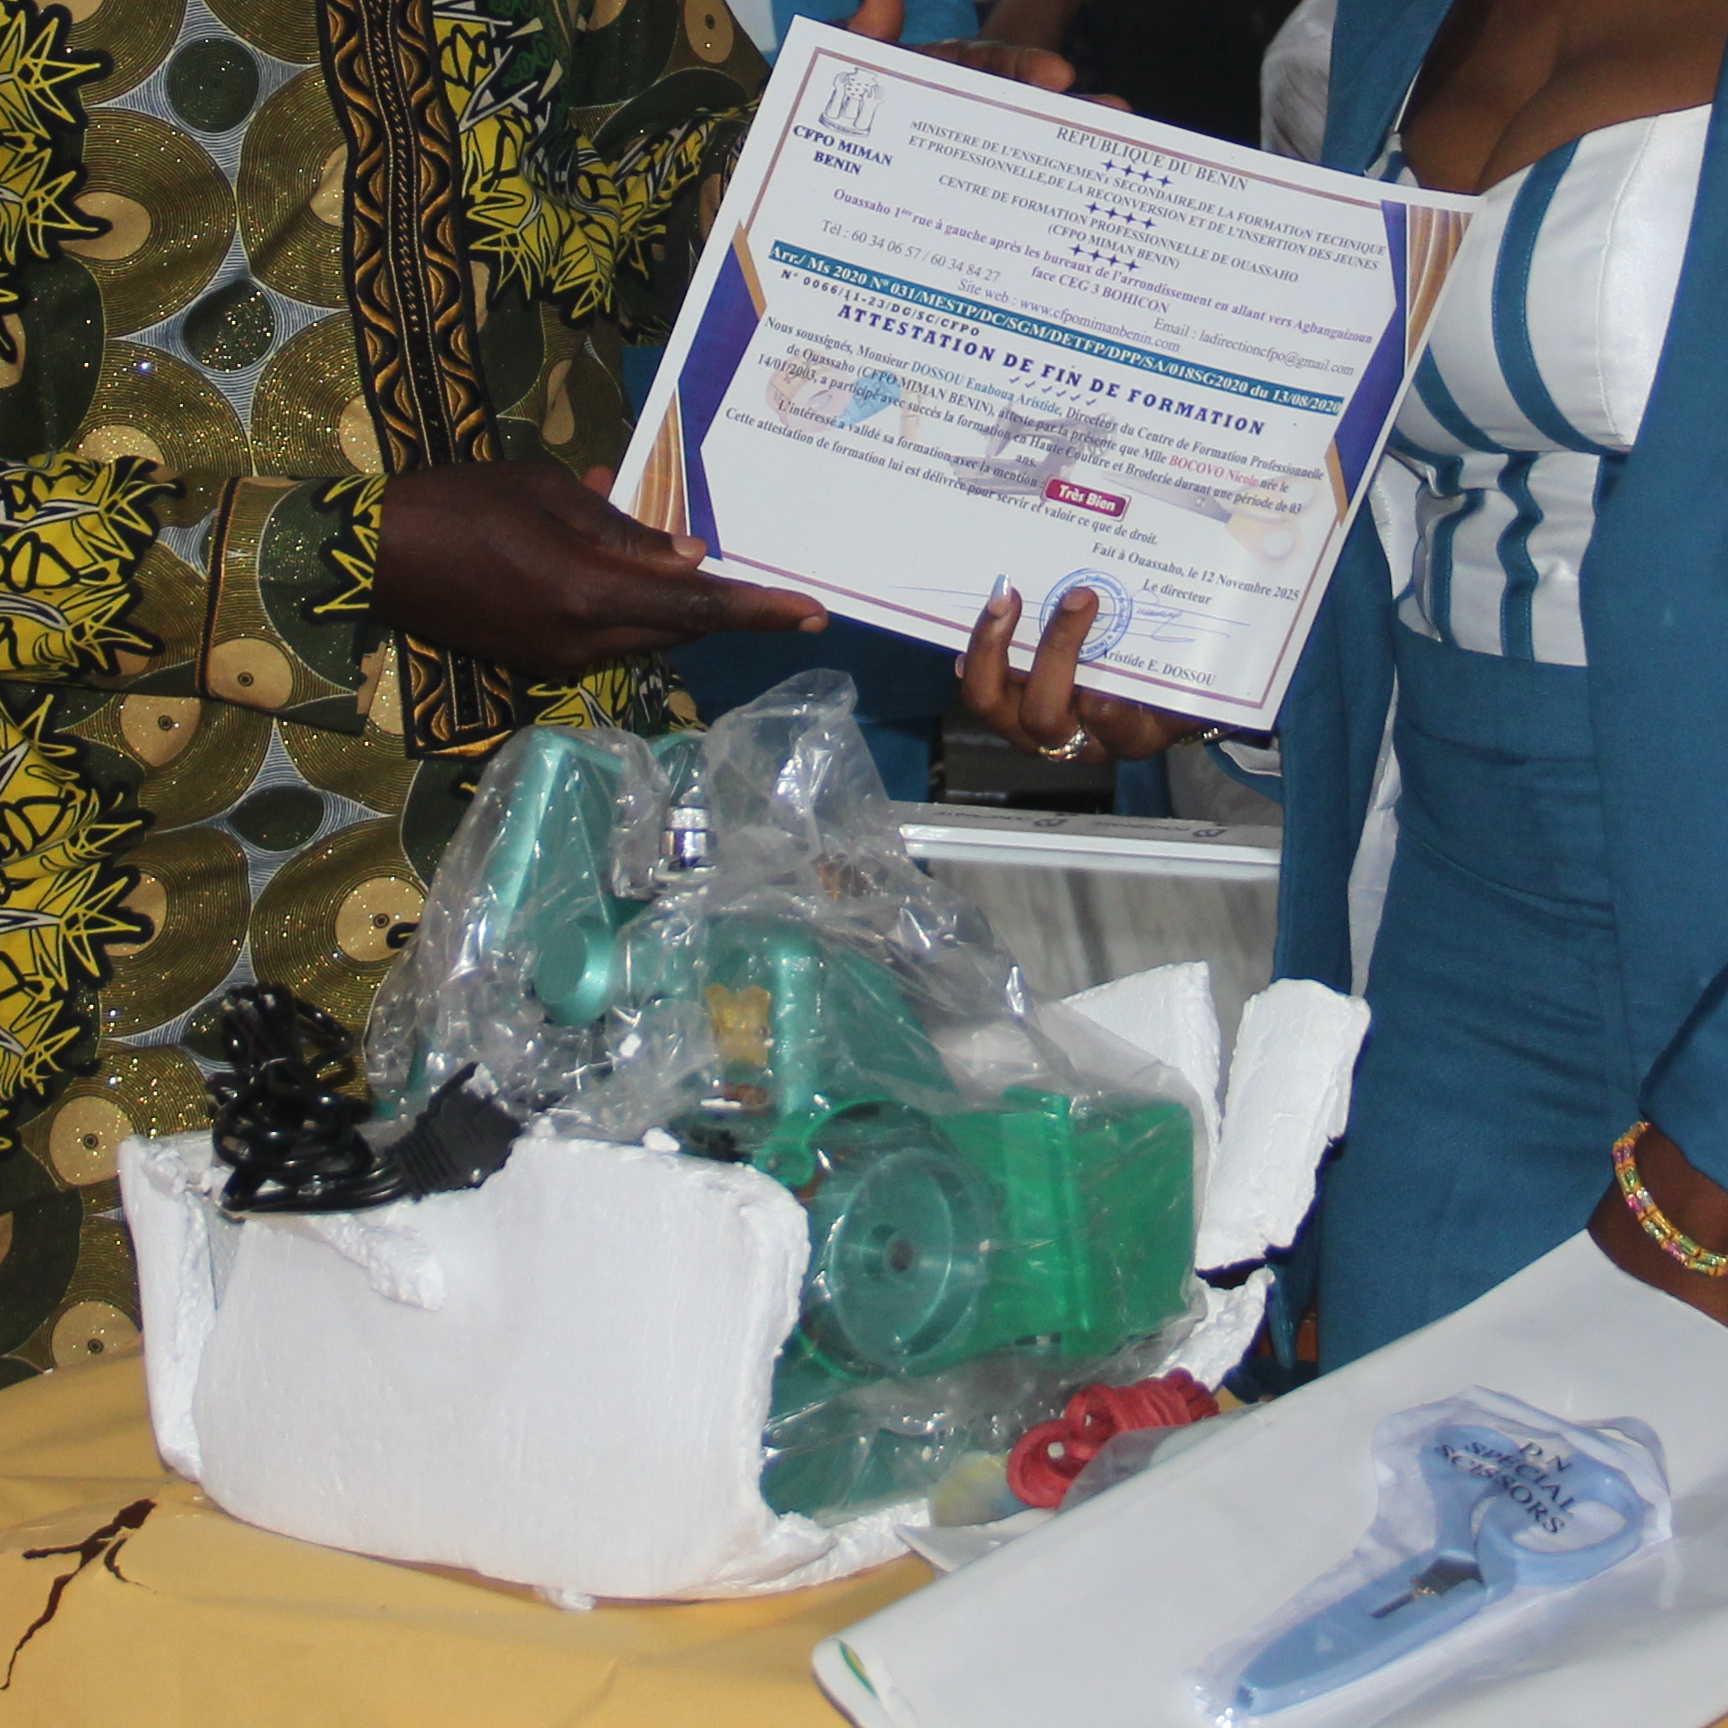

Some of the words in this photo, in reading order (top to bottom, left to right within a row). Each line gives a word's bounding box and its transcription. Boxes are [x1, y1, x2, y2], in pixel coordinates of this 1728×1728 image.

[791, 123, 836, 147] CFPO
[836, 138, 892, 166] MIMAN
[812, 150, 862, 175] BENIN
[1055, 126, 1165, 169] REPUBLIQUE
[1166, 158, 1188, 175] DU
[1194, 166, 1248, 191] BENIN
[907, 134, 927, 149] ET
[1066, 180, 1084, 194] LA
[1085, 185, 1186, 222] RECONVERSION
[1187, 214, 1206, 228] ET
[1206, 219, 1226, 233] DE
[1226, 224, 1307, 254] L'INSERTION
[1307, 245, 1333, 261] DES
[1332, 251, 1378, 270] JEUNES
[937, 173, 990, 197] CENTRE
[990, 188, 1010, 203] DE
[1010, 194, 1088, 225] FORMATION
[1088, 217, 1209, 259] PROFESSIONNELLE
[1210, 250, 1230, 265] DE
[1229, 256, 1299, 283] OUASSAHO
[980, 138, 1000, 153] DE
[1216, 205, 1235, 220] LA
[1236, 210, 1312, 239] FORMATION
[1314, 230, 1387, 256] TECHNIQUE
[820, 219, 842, 237] Tél
[849, 229, 868, 244] 60
[868, 234, 886, 249] 34
[885, 239, 903, 255] 06
[903, 244, 922, 260] 57
[929, 252, 947, 268] 60
[947, 256, 965, 273] 34
[965, 262, 983, 278] 84
[982, 267, 1001, 283] 27
[832, 187, 891, 215] Ouassaho
[911, 212, 934, 228] rue
[943, 222, 988, 245] gauche
[987, 235, 1022, 255] après
[1022, 244, 1041, 259] les
[1042, 250, 1093, 274] bureaux
[1094, 265, 1111, 279] de
[1110, 269, 1212, 307] l'arrondissement
[1230, 303, 1266, 321] allant
[1267, 313, 1293, 327] vers
[1046, 223, 1087, 242] (CFPO
[1087, 233, 1134, 256] MIMAN
[1135, 247, 1180, 269] BENIN)
[956, 278, 982, 296] Site
[983, 287, 1010, 304] web
[1018, 298, 1180, 353] www.cfpomimanbenin.com
[1029, 265, 1057, 283] face
[1057, 273, 1090, 292] CEG
[1100, 285, 1168, 314] BOHICON
[806, 256, 831, 274] Ms
[831, 264, 868, 285] 2020
[1248, 383, 1270, 398] du
[1271, 388, 1341, 416] 13/08/2020
[837, 303, 995, 361] ATTESTATION
[1002, 352, 1034, 373] DE
[1040, 363, 1082, 386] FIN
[1088, 376, 1121, 397] DE
[1126, 388, 1264, 435] FORMATION
[1152, 316, 1191, 337] Email
[1198, 329, 1354, 377] ladirectioncfpo@gmail.com
[763, 315, 794, 335] Nous
[794, 326, 854, 355] soussignés,
[855, 344, 910, 370] Monsieur
[910, 360, 962, 386] DOSSOU
[964, 376, 1015, 402] Enaboua
[1017, 392, 1064, 416] Aristide,
[1065, 406, 1119, 431] Directeur
[1119, 421, 1136, 436] du
[1136, 426, 1175, 446] Centre
[1175, 436, 1191, 450] de
[1191, 440, 1248, 464] Formation
[1249, 455, 1324, 480] Professionnelle
[785, 342, 801, 357] de
[801, 347, 856, 373] Ouassaho
[856, 365, 898, 386] (CFPO
[898, 376, 946, 400] MIMAN
[947, 391, 996, 416] BENIN),
[997, 407, 1034, 427] atteste
[1034, 419, 1058, 434] par
[1069, 429, 1118, 451] présente
[1117, 443, 1141, 457] que
[1140, 447, 1168, 464] Mlle
[1167, 454, 1225, 478] BOCOVO
[1225, 468, 1259, 488] Nicole
[1258, 477, 1279, 491] née
[724, 407, 756, 427] Cette
[755, 418, 814, 445] attestation
[815, 435, 831, 450] de
[830, 440, 886, 467] formation
[886, 457, 904, 472] lui
[903, 464, 921, 477] est
[920, 468, 967, 491] délivrée
[965, 482, 997, 500] pour
[995, 489, 1030, 510] servir
[1043, 505, 1077, 523] valoir
[1076, 515, 1091, 527] ce
[1090, 519, 1113, 534] que
[1113, 523, 1128, 537] de
[1128, 528, 1158, 546] droit.
[827, 376, 880, 401] participé
[879, 392, 906, 408] avec
[906, 399, 942, 419] succès
[955, 413, 1013, 441] formation
[1028, 434, 1064, 455] Haute
[1063, 445, 1111, 468] Couture
[1124, 462, 1173, 485] Broderie
[1173, 475, 1212, 495] durant
[1212, 486, 1234, 500] une
[1232, 491, 1274, 510] période
[1273, 499, 1289, 512] de
[1288, 501, 1302, 515] 03
[847, 422, 882, 441] validé
[881, 432, 895, 446] sa
[895, 435, 952, 462] formation
[950, 454, 979, 470] avec
[992, 465, 1038, 487] mention
[1013, 453, 1037, 468] ans.
[1057, 483, 1085, 503] Très
[1085, 491, 1117, 512] Bien
[1091, 541, 1117, 558] Fait
[1126, 551, 1186, 576] Ouassaho,
[1200, 570, 1216, 583] 12
[1215, 573, 1273, 596] Novembre
[1272, 585, 1300, 601] 2025
[1141, 577, 1159, 592] Le
[1159, 583, 1212, 605] directeur
[1146, 658, 1159, 672] E.
[1161, 663, 1213, 686] DOSSOU
[1434, 1443, 1565, 1534] SCISSORS
[1465, 1441, 1575, 1517] SPECIAL
